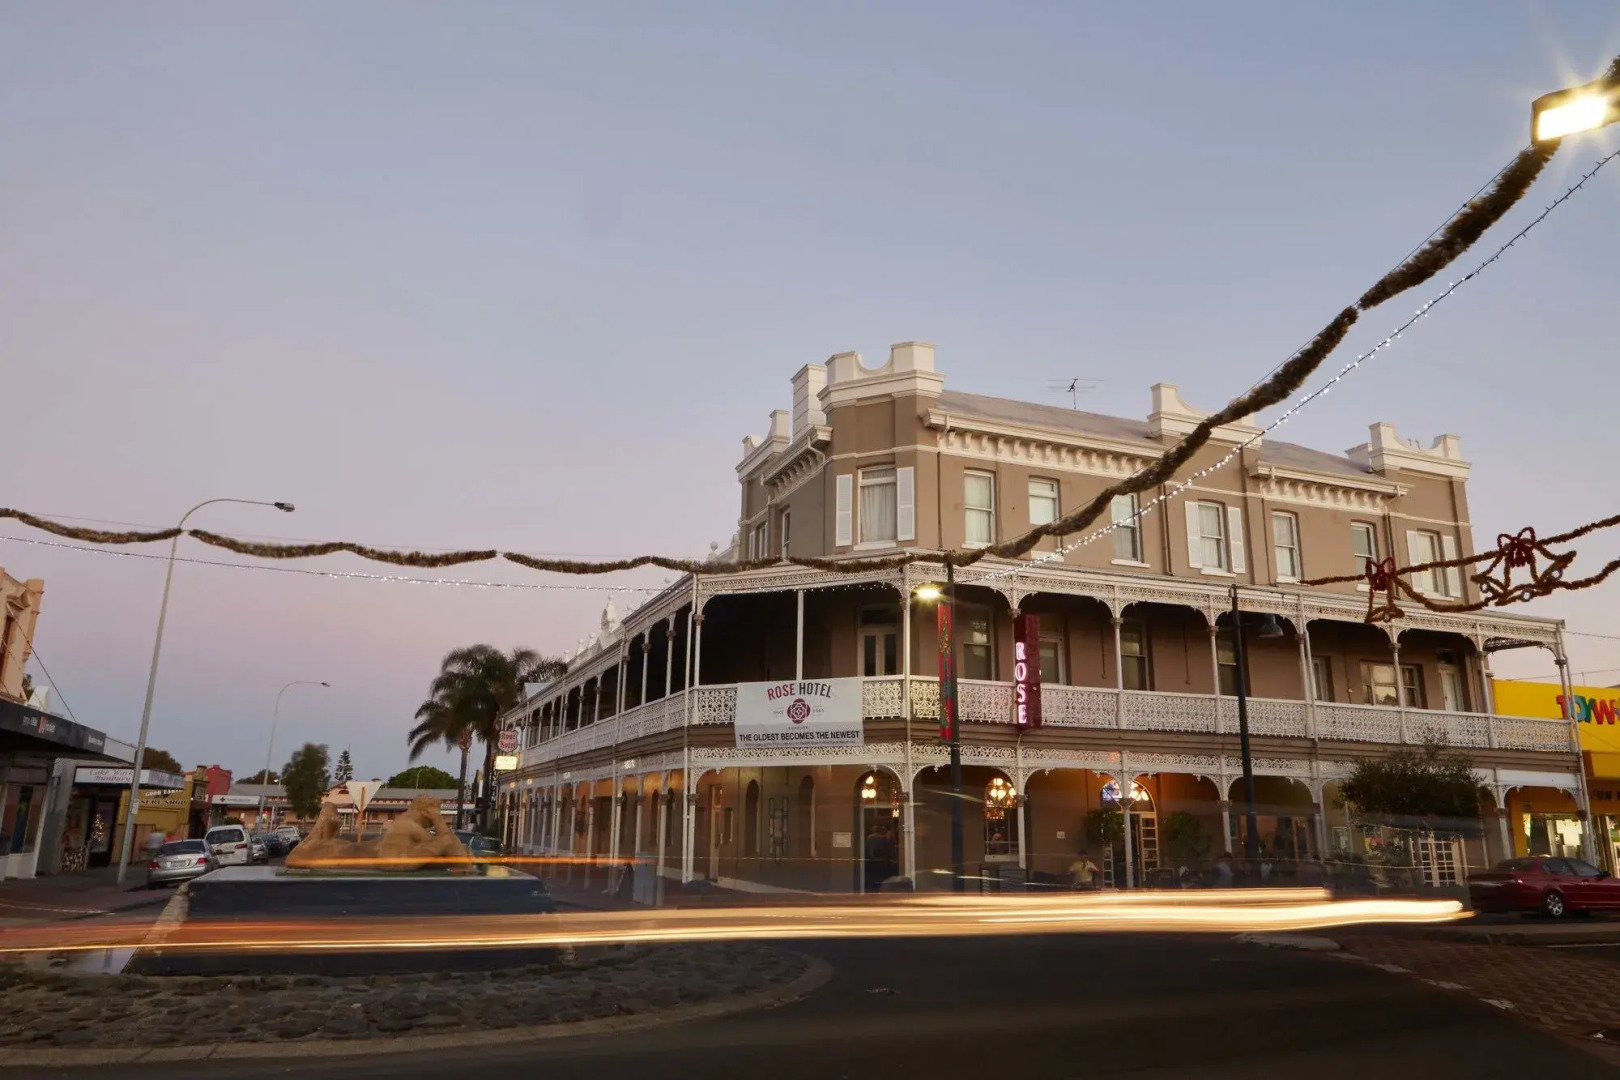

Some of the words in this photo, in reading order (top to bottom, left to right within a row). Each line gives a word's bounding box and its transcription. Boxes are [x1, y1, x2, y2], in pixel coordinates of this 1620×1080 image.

[767, 683, 796, 701] ROSE
[798, 682, 832, 698] HOTEL
[1014, 641, 1028, 724] ROSE
[1555, 694, 1620, 725] TOYW
[500, 732, 516, 740] Rose
[739, 734, 752, 742] THE
[753, 733, 779, 742] OLDEST
[780, 732, 815, 741] BECOMES
[815, 731, 830, 740] THE
[830, 730, 860, 739] NEWEST
